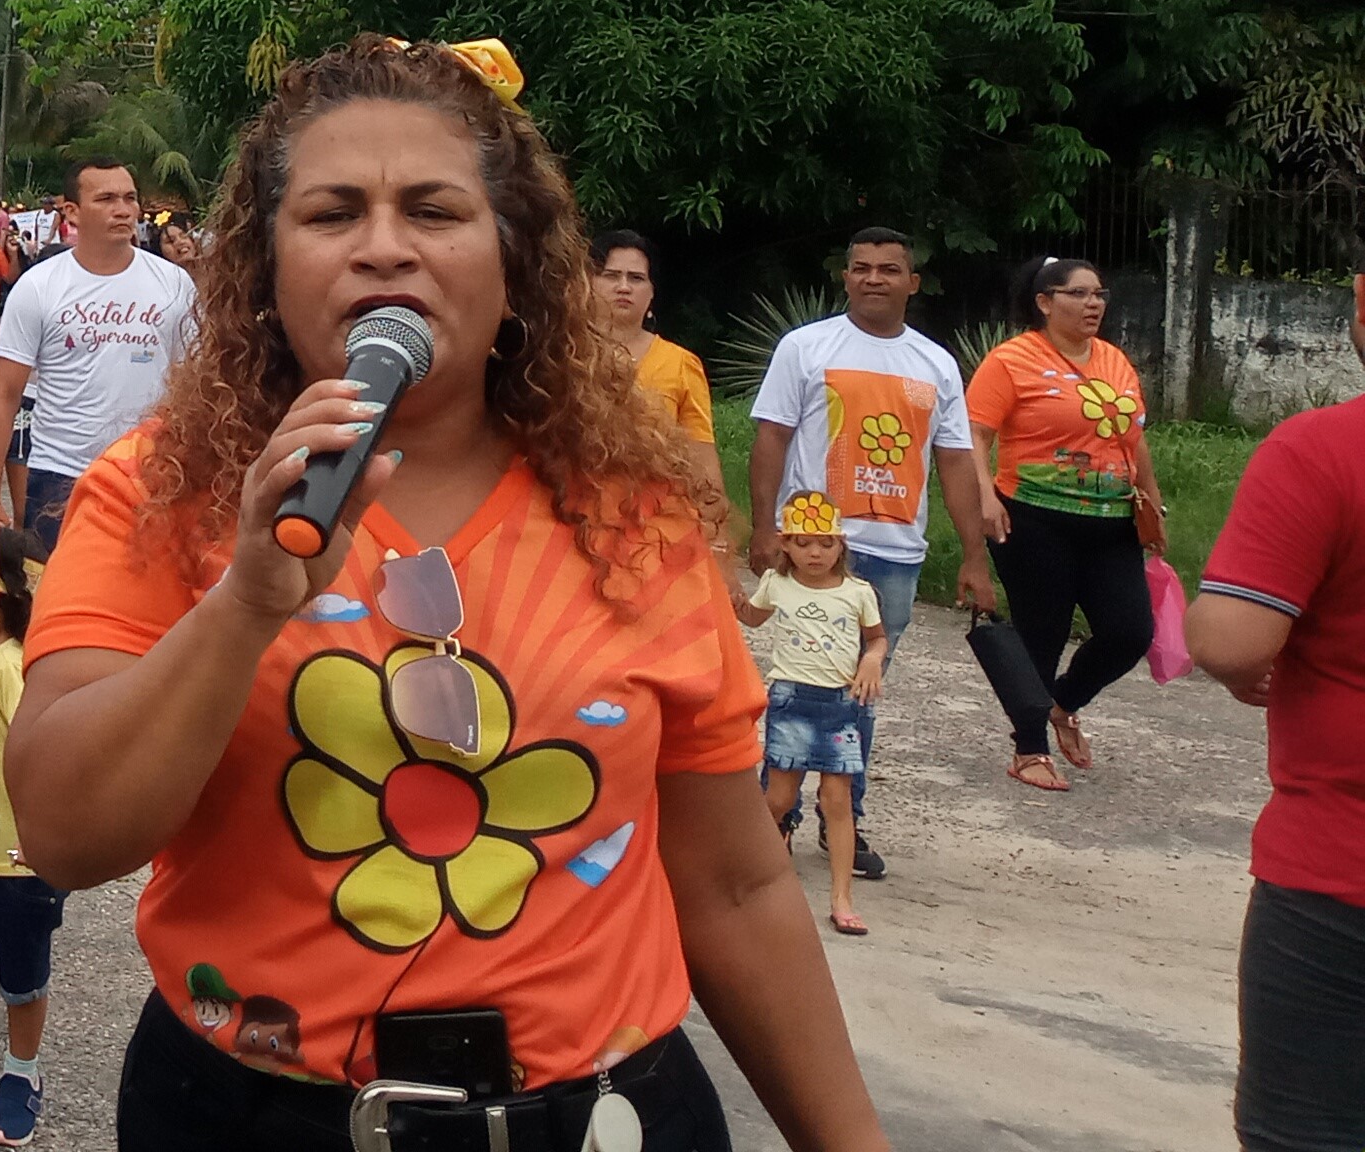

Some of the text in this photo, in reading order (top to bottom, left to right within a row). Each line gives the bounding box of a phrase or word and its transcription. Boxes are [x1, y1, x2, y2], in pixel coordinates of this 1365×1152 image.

[58, 300, 165, 328] Natal de
[77, 325, 159, 353] Esperança
[854, 479, 907, 499] BONITO
